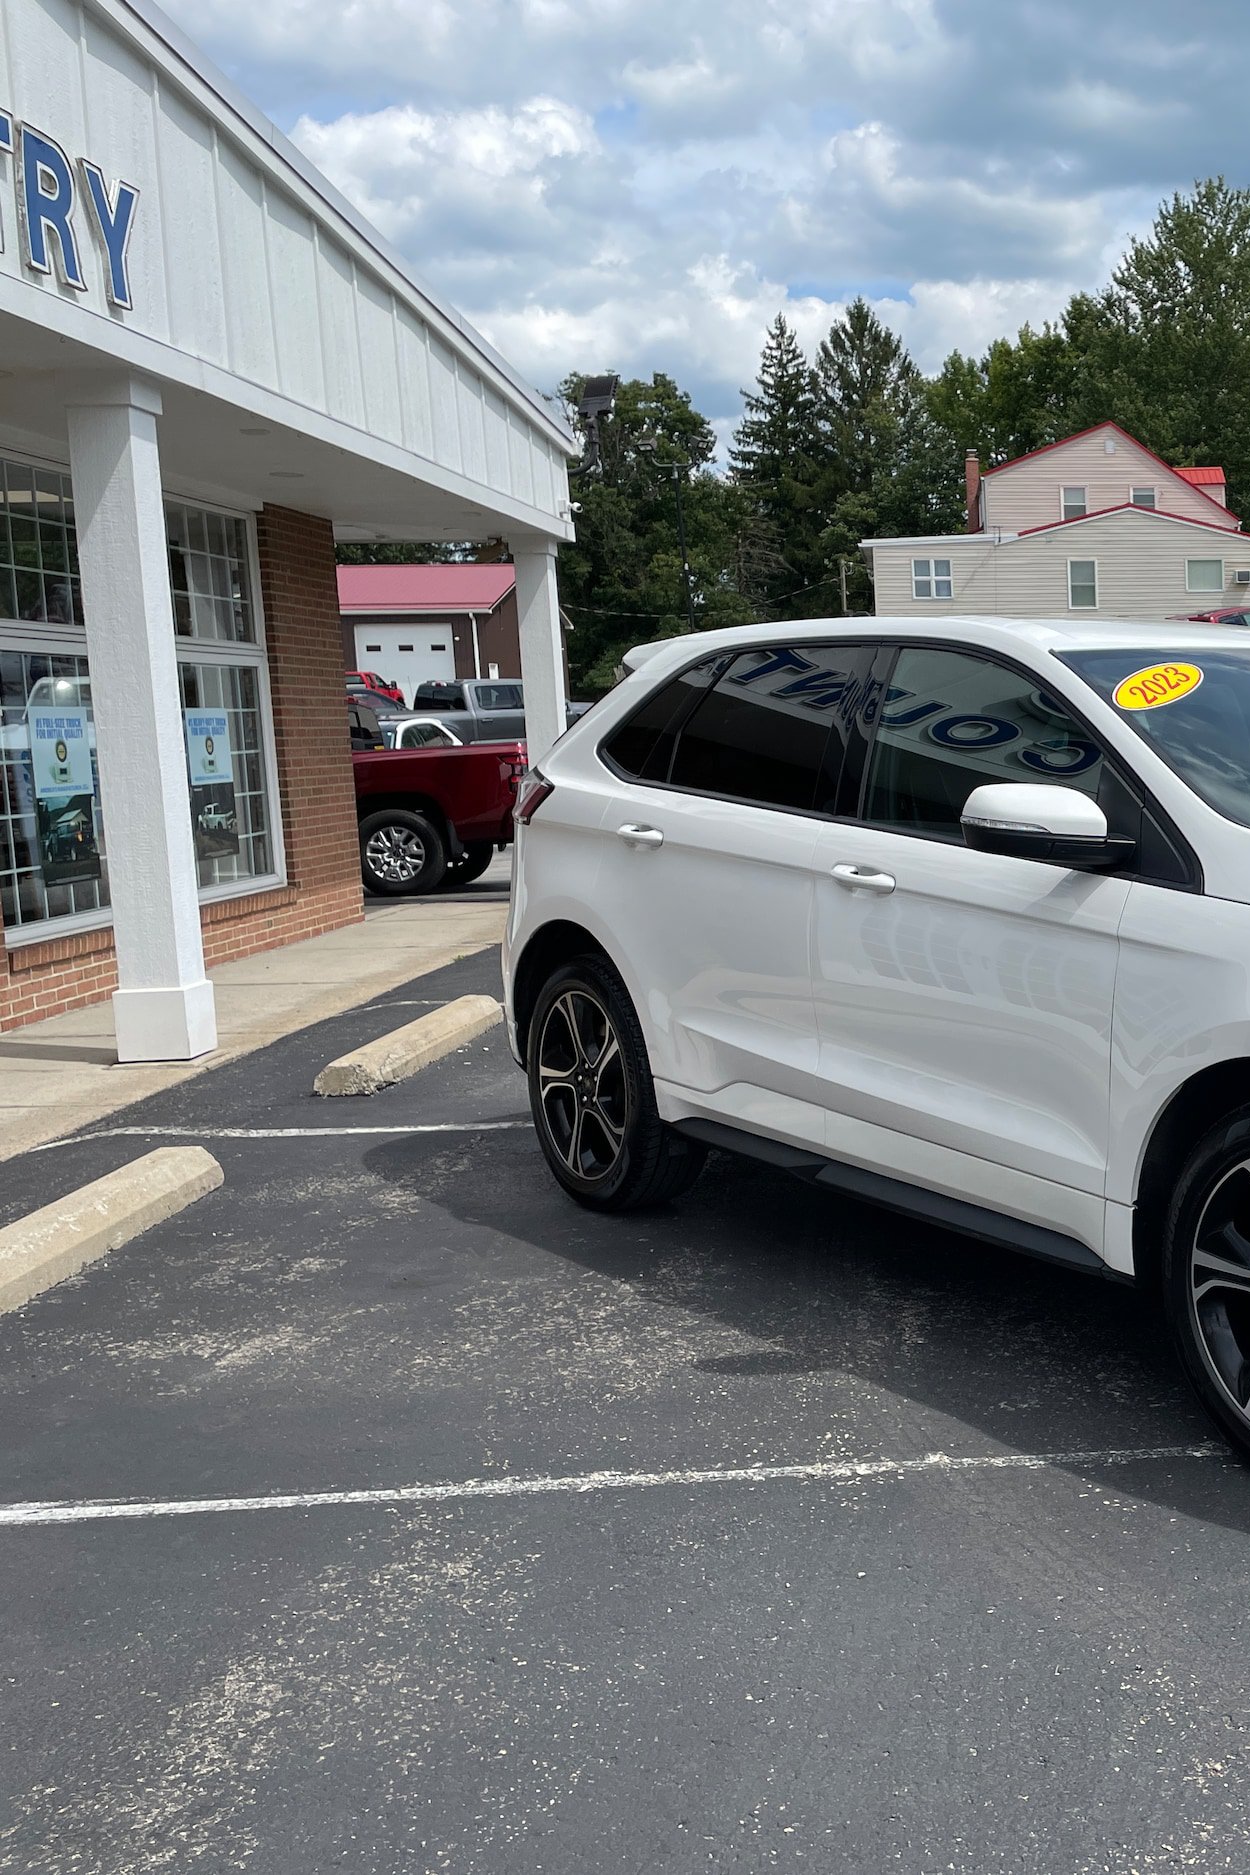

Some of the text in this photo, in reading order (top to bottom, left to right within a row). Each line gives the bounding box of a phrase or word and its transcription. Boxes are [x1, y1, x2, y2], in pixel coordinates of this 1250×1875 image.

[1129, 666, 1190, 705] 2023
[43, 718, 65, 728] FULL-SIZE
[66, 718, 81, 728] TRUCK
[36, 729, 83, 740] FOR INITIAL QUALITY
